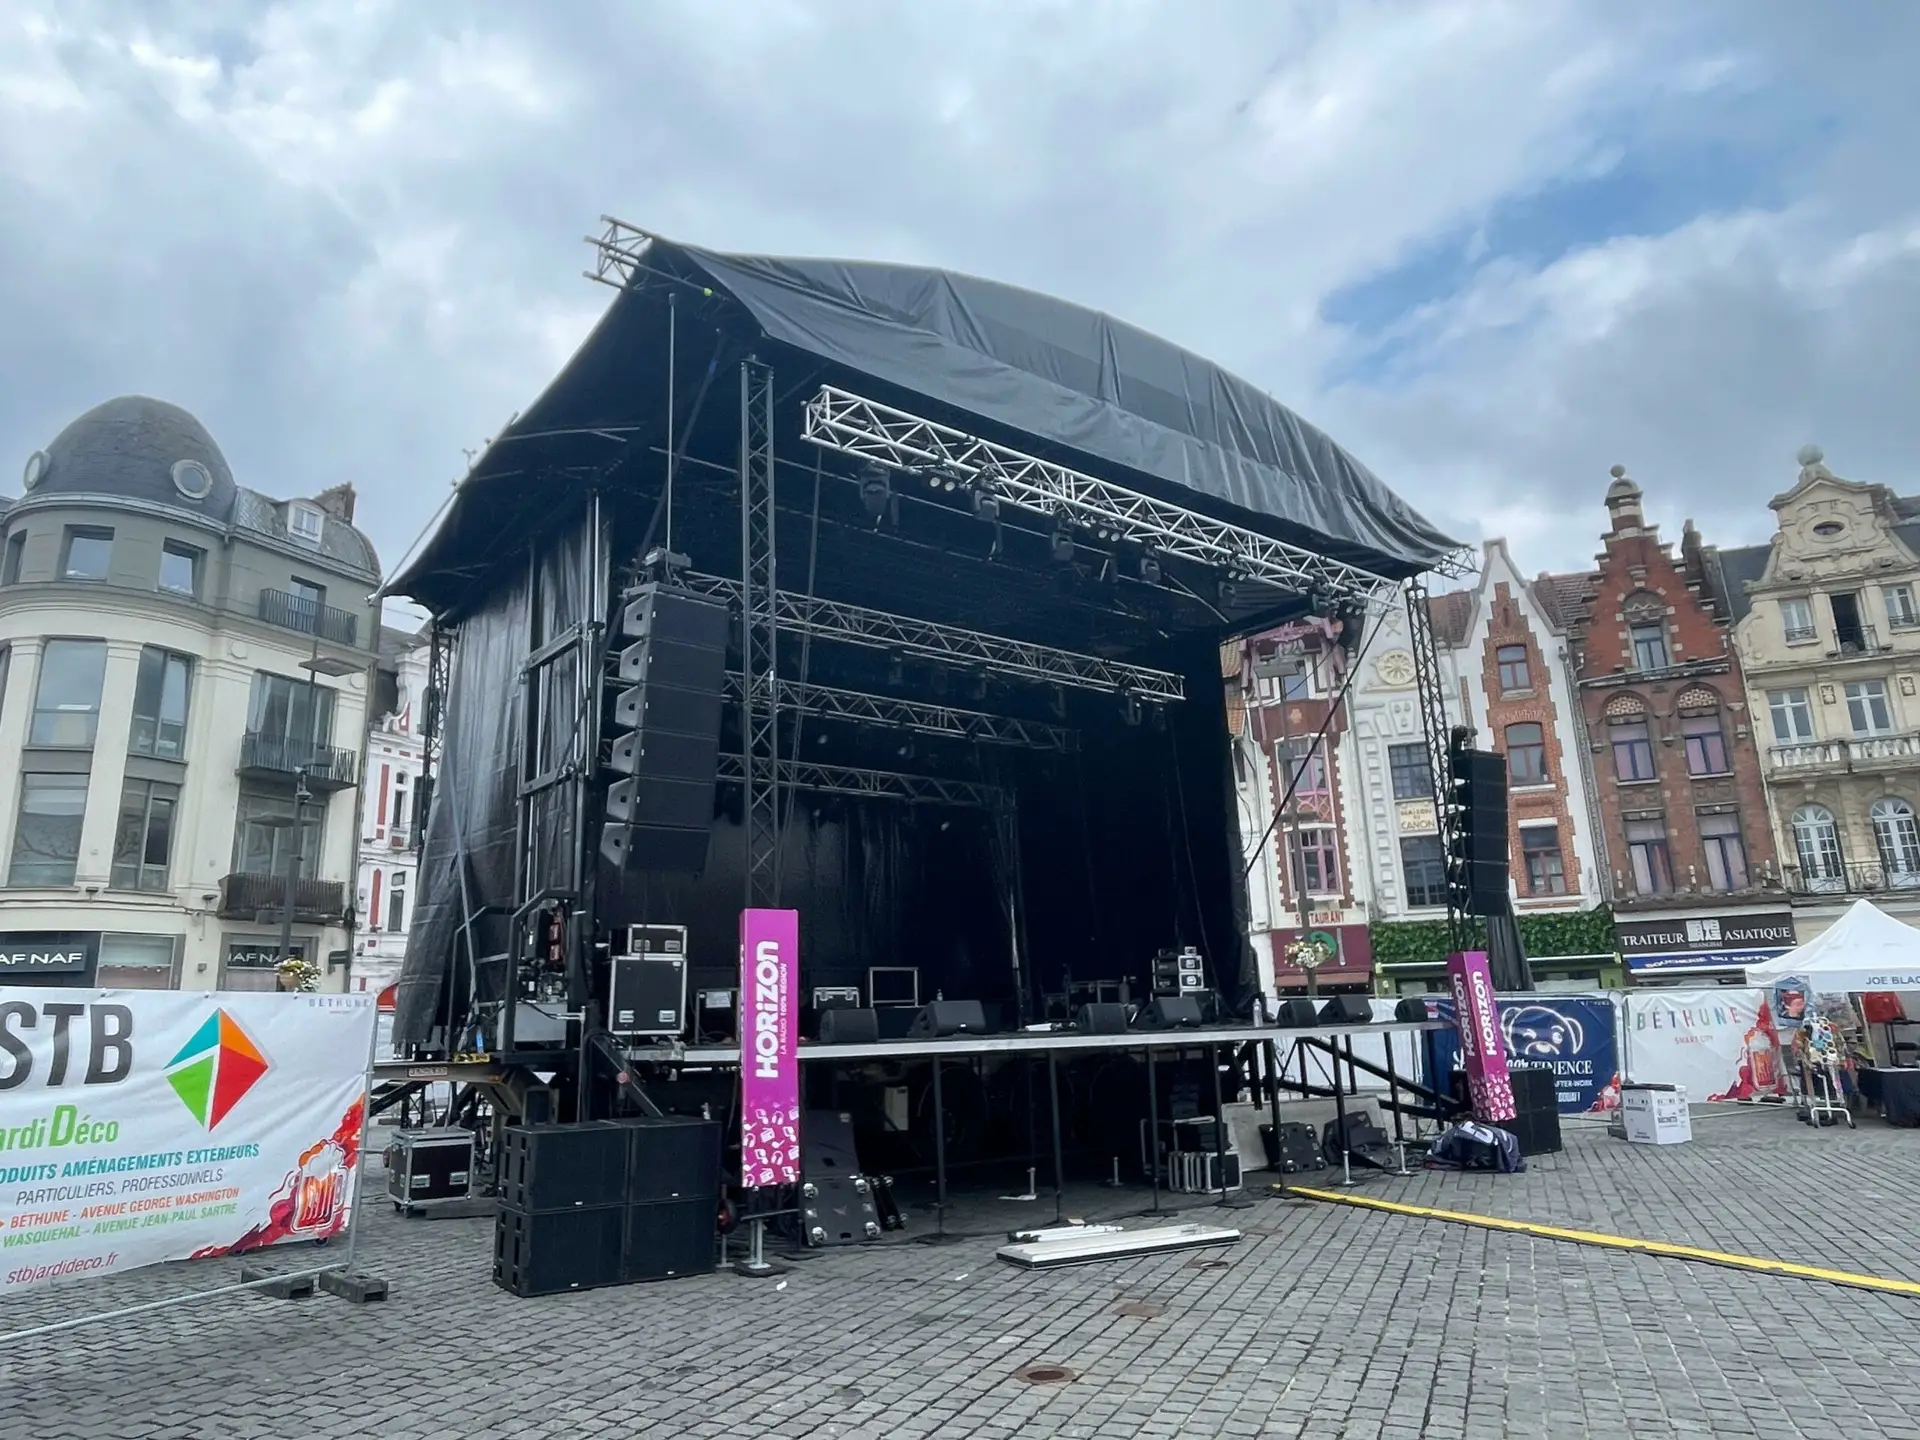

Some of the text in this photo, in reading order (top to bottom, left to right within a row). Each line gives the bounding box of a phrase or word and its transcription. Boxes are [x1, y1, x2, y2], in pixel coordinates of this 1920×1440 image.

[1295, 911, 1344, 925] RTAURANT
[1621, 933, 1686, 946] TRAITEUR
[1724, 927, 1792, 941] ASIATIQUE
[30, 953, 83, 964] NAF
[227, 952, 257, 963] AF
[1865, 976, 1889, 985] JOE
[780, 995, 788, 1016] 100%
[1637, 1006, 1742, 1031] BÉTHUNE
[780, 1018, 788, 1043] RADIO
[780, 1044, 788, 1055] LA
[61, 1151, 183, 1178] AMÉNAGEMENTS
[121, 1168, 224, 1194] PROFESSIONNELS
[80, 1202, 127, 1219] AVENUE
[129, 1196, 172, 1212] GEORGE
[175, 1188, 240, 1206] WASHINGTON
[3, 1226, 81, 1248] WASQUEHAL
[92, 1217, 139, 1235] AVENUE
[140, 1208, 197, 1228] JEAN-PAUL
[199, 1203, 237, 1219] SARTRE
[6, 1251, 119, 1284] stbjardideco.fr
